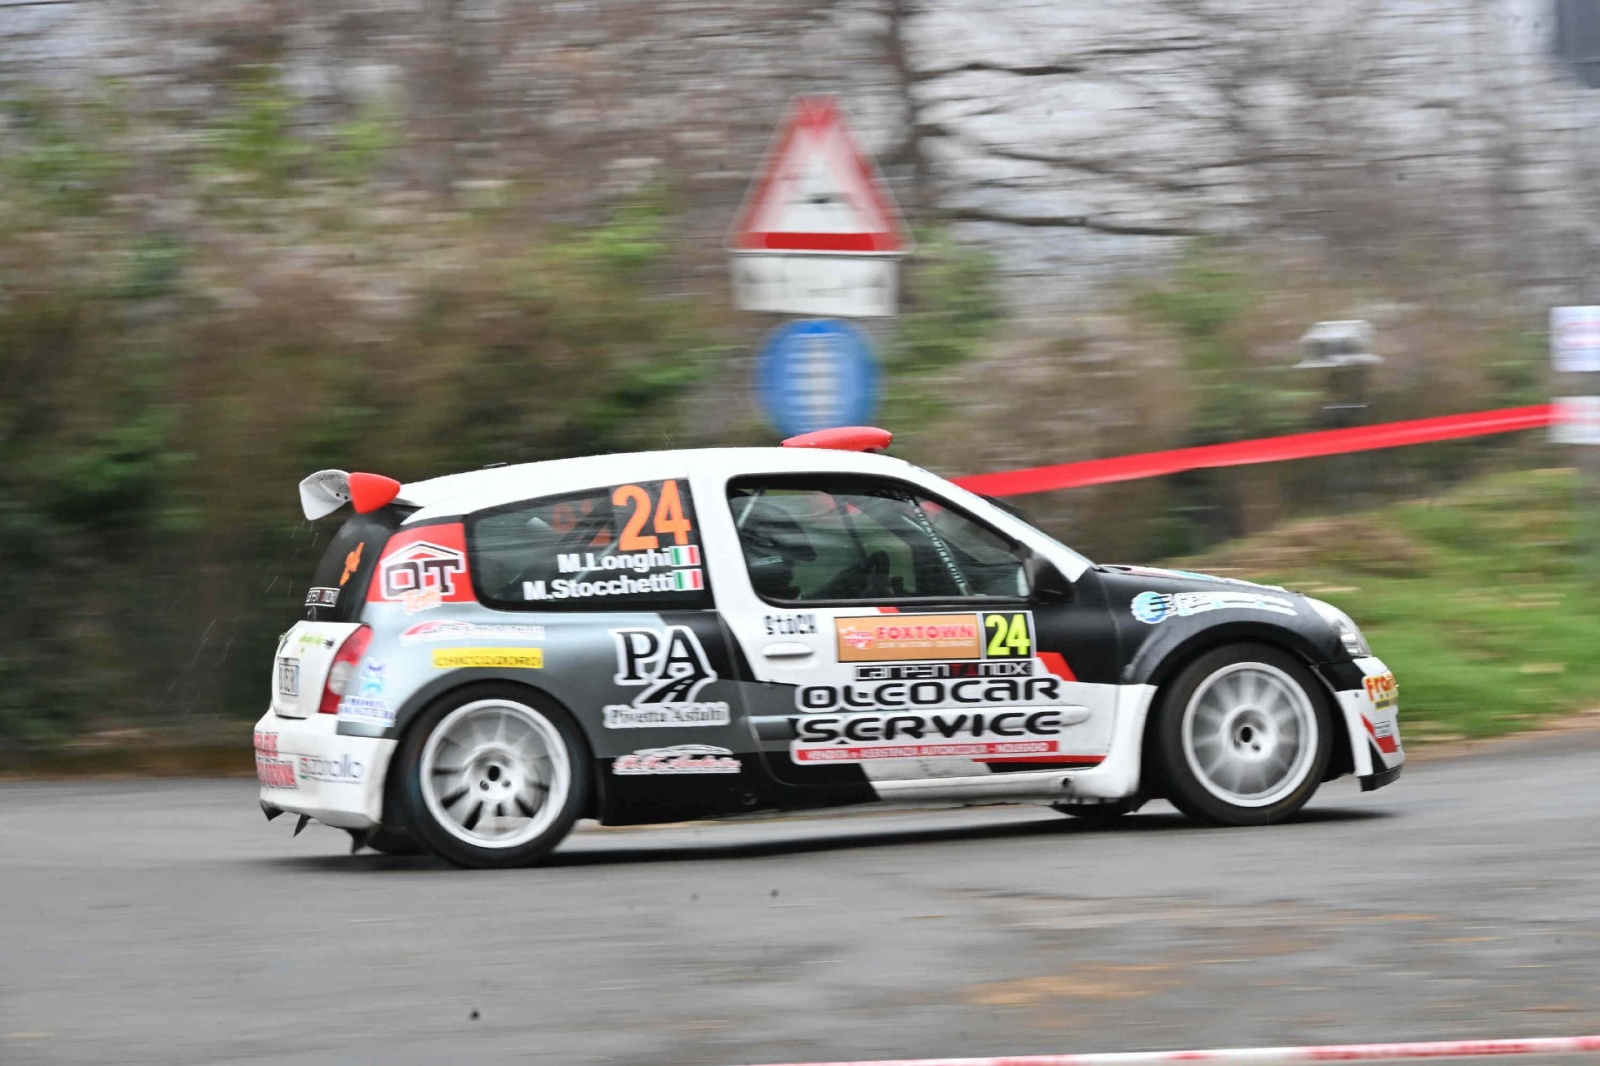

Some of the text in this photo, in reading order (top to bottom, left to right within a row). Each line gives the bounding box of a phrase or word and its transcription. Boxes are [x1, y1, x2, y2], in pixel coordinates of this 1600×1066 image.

[612, 479, 692, 552] 24
[556, 548, 671, 574] M.Longhi
[522, 573, 675, 601] M.Stocchetti
[876, 624, 975, 641] FOXTOWN
[984, 613, 1031, 656] 24
[608, 629, 712, 682] PA
[802, 711, 1062, 743] SERVICE
